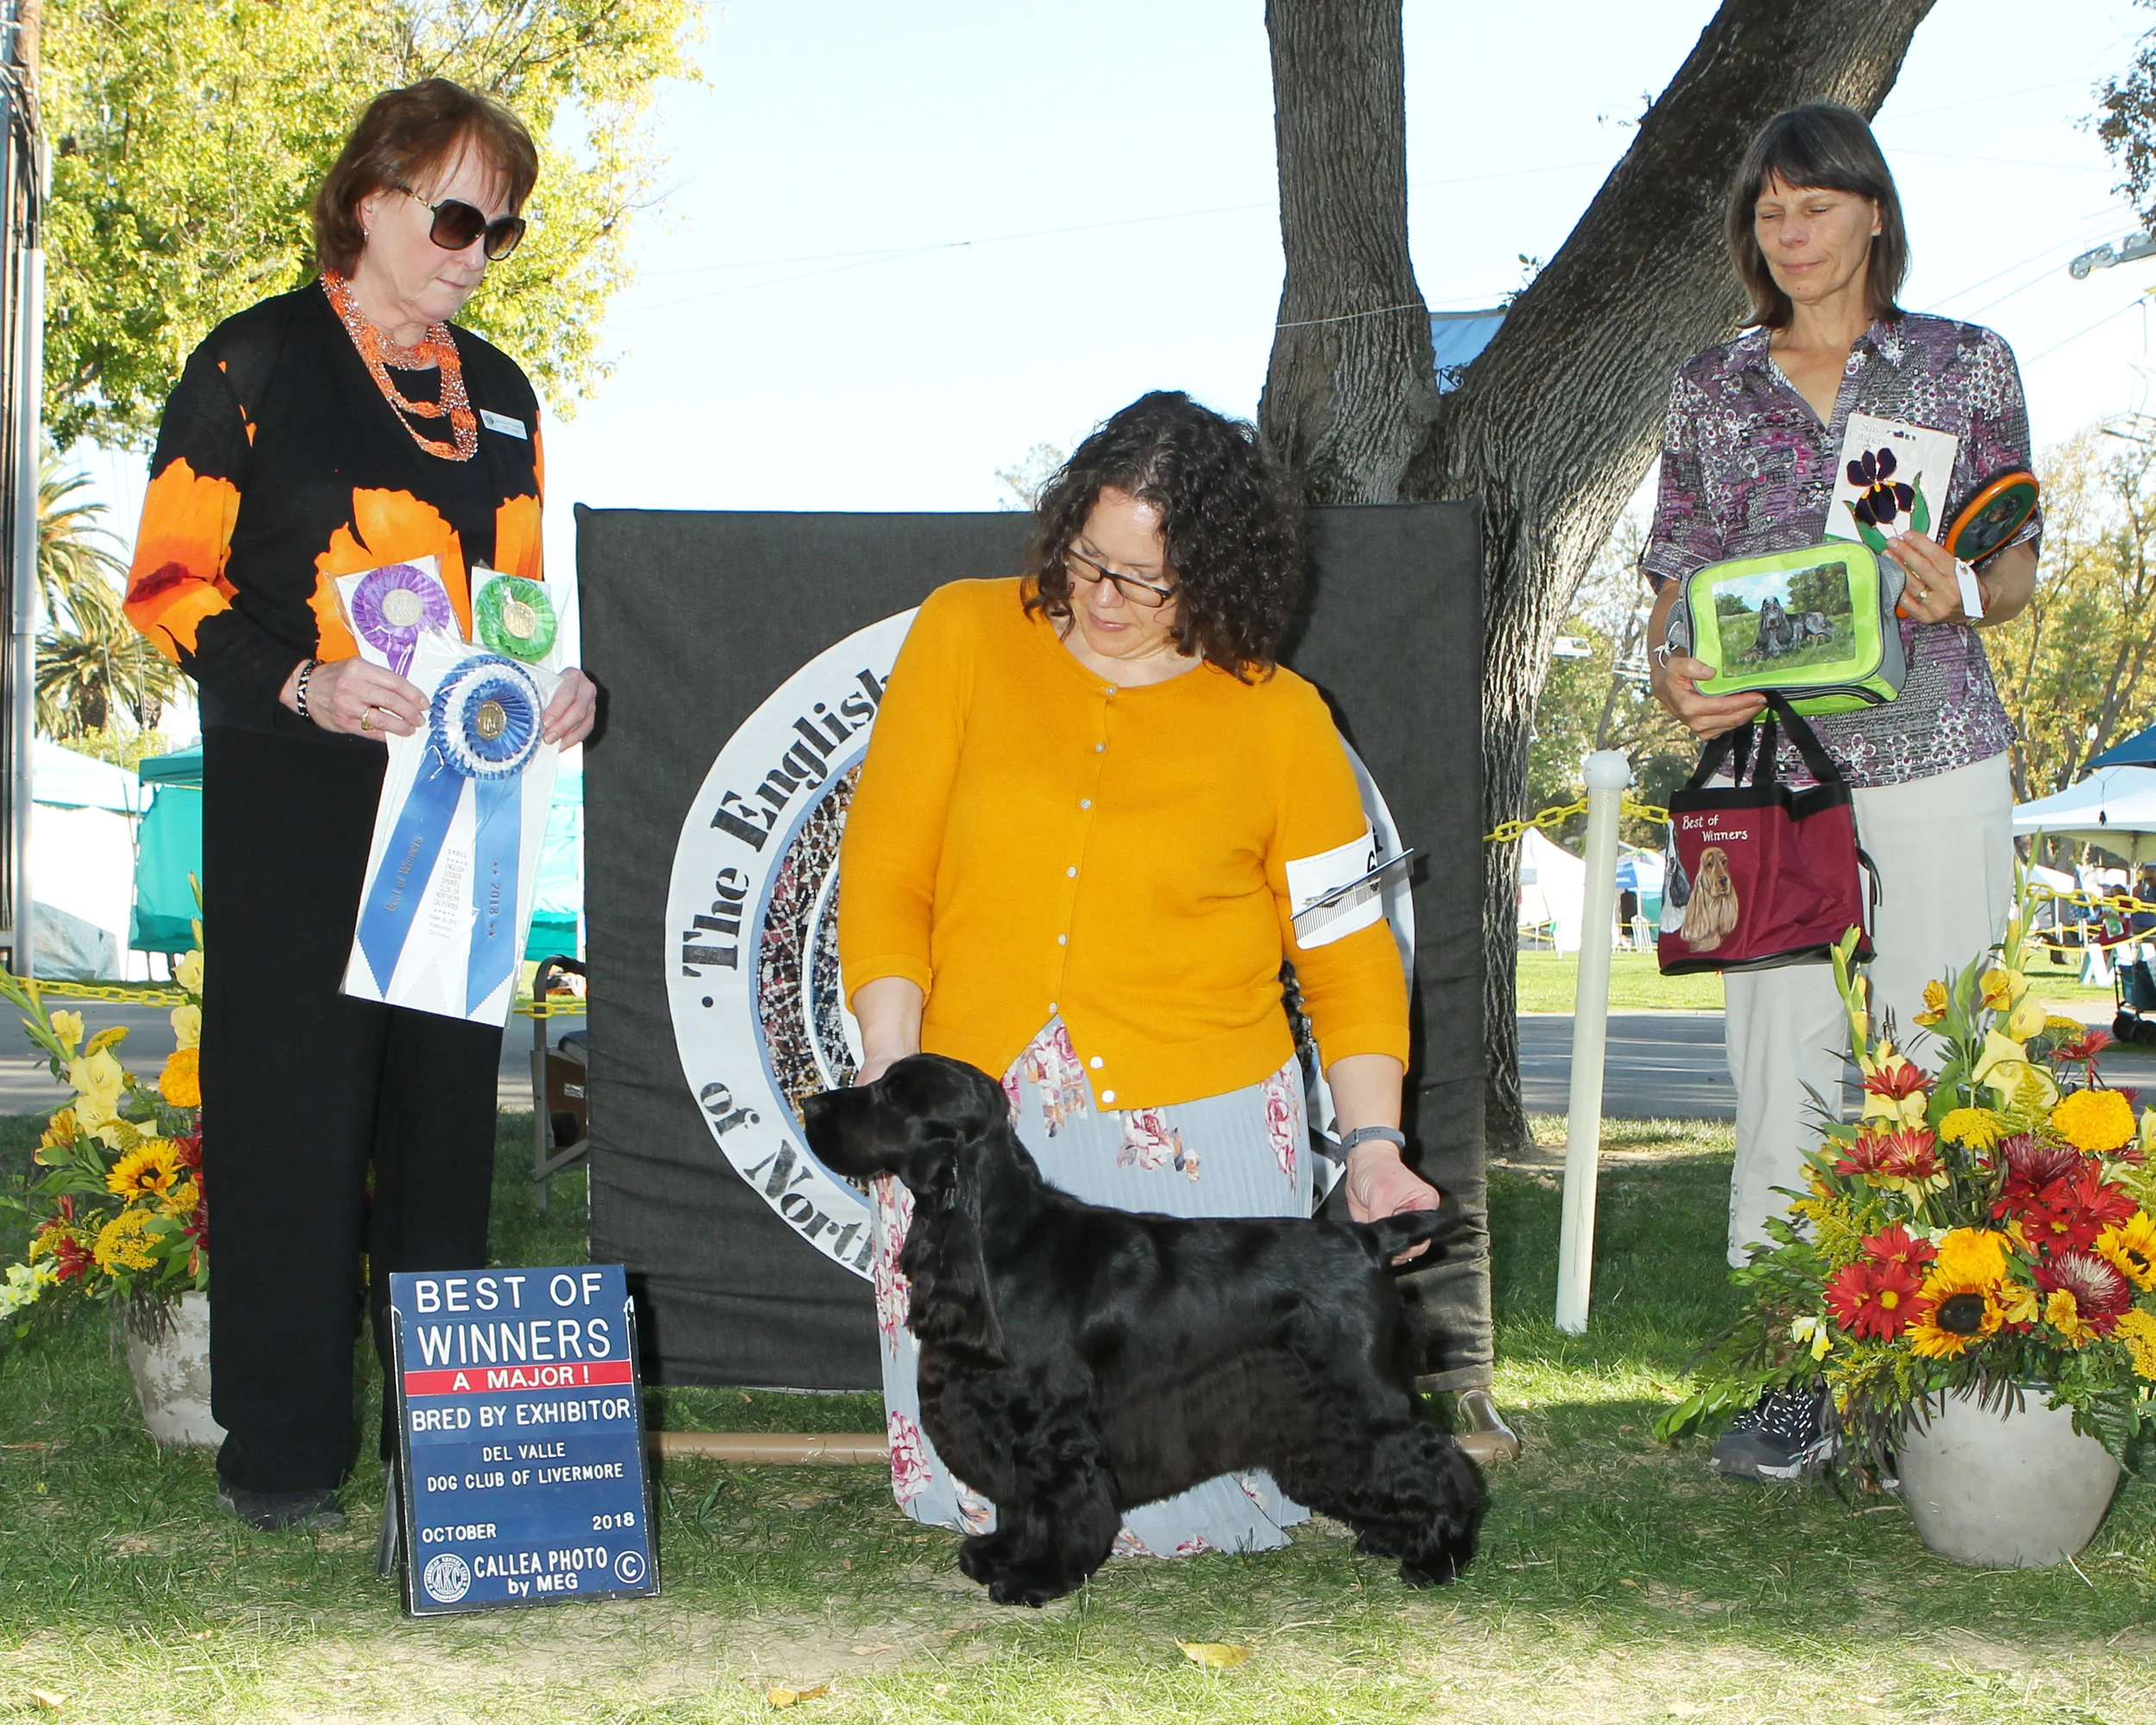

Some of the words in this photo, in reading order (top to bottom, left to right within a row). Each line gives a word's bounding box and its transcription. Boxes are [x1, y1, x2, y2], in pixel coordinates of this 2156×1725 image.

[1683, 815, 1703, 830] Best
[1708, 814, 1719, 825] of
[1702, 830, 1748, 842] Winners
[398, 835, 423, 874] Winners
[396, 876, 406, 889] of
[385, 889, 402, 912] Best
[489, 883, 500, 914] 2018
[682, 868, 749, 977] The
[700, 1082, 760, 1137] of
[416, 1276, 525, 1313] BEST
[550, 1273, 601, 1306] OF
[417, 1319, 611, 1366] WINNERS
[453, 1372, 470, 1390] A
[487, 1366, 574, 1389] MAJOR
[412, 1408, 471, 1431] BRED
[479, 1406, 506, 1427] BY
[517, 1399, 630, 1425] EXHIBITOR
[483, 1446, 512, 1461] DEL
[518, 1443, 565, 1458] VALLE
[428, 1476, 457, 1491] DOG
[466, 1472, 504, 1489] CLUB
[512, 1471, 530, 1485] OF
[539, 1464, 624, 1483] LIVERMORE
[423, 1524, 496, 1543] OCTOBER
[592, 1512, 634, 1530] 2018
[474, 1552, 540, 1579] CALLEA
[548, 1547, 607, 1571] PHOTO
[508, 1578, 530, 1596] by
[537, 1572, 578, 1591] MEG
